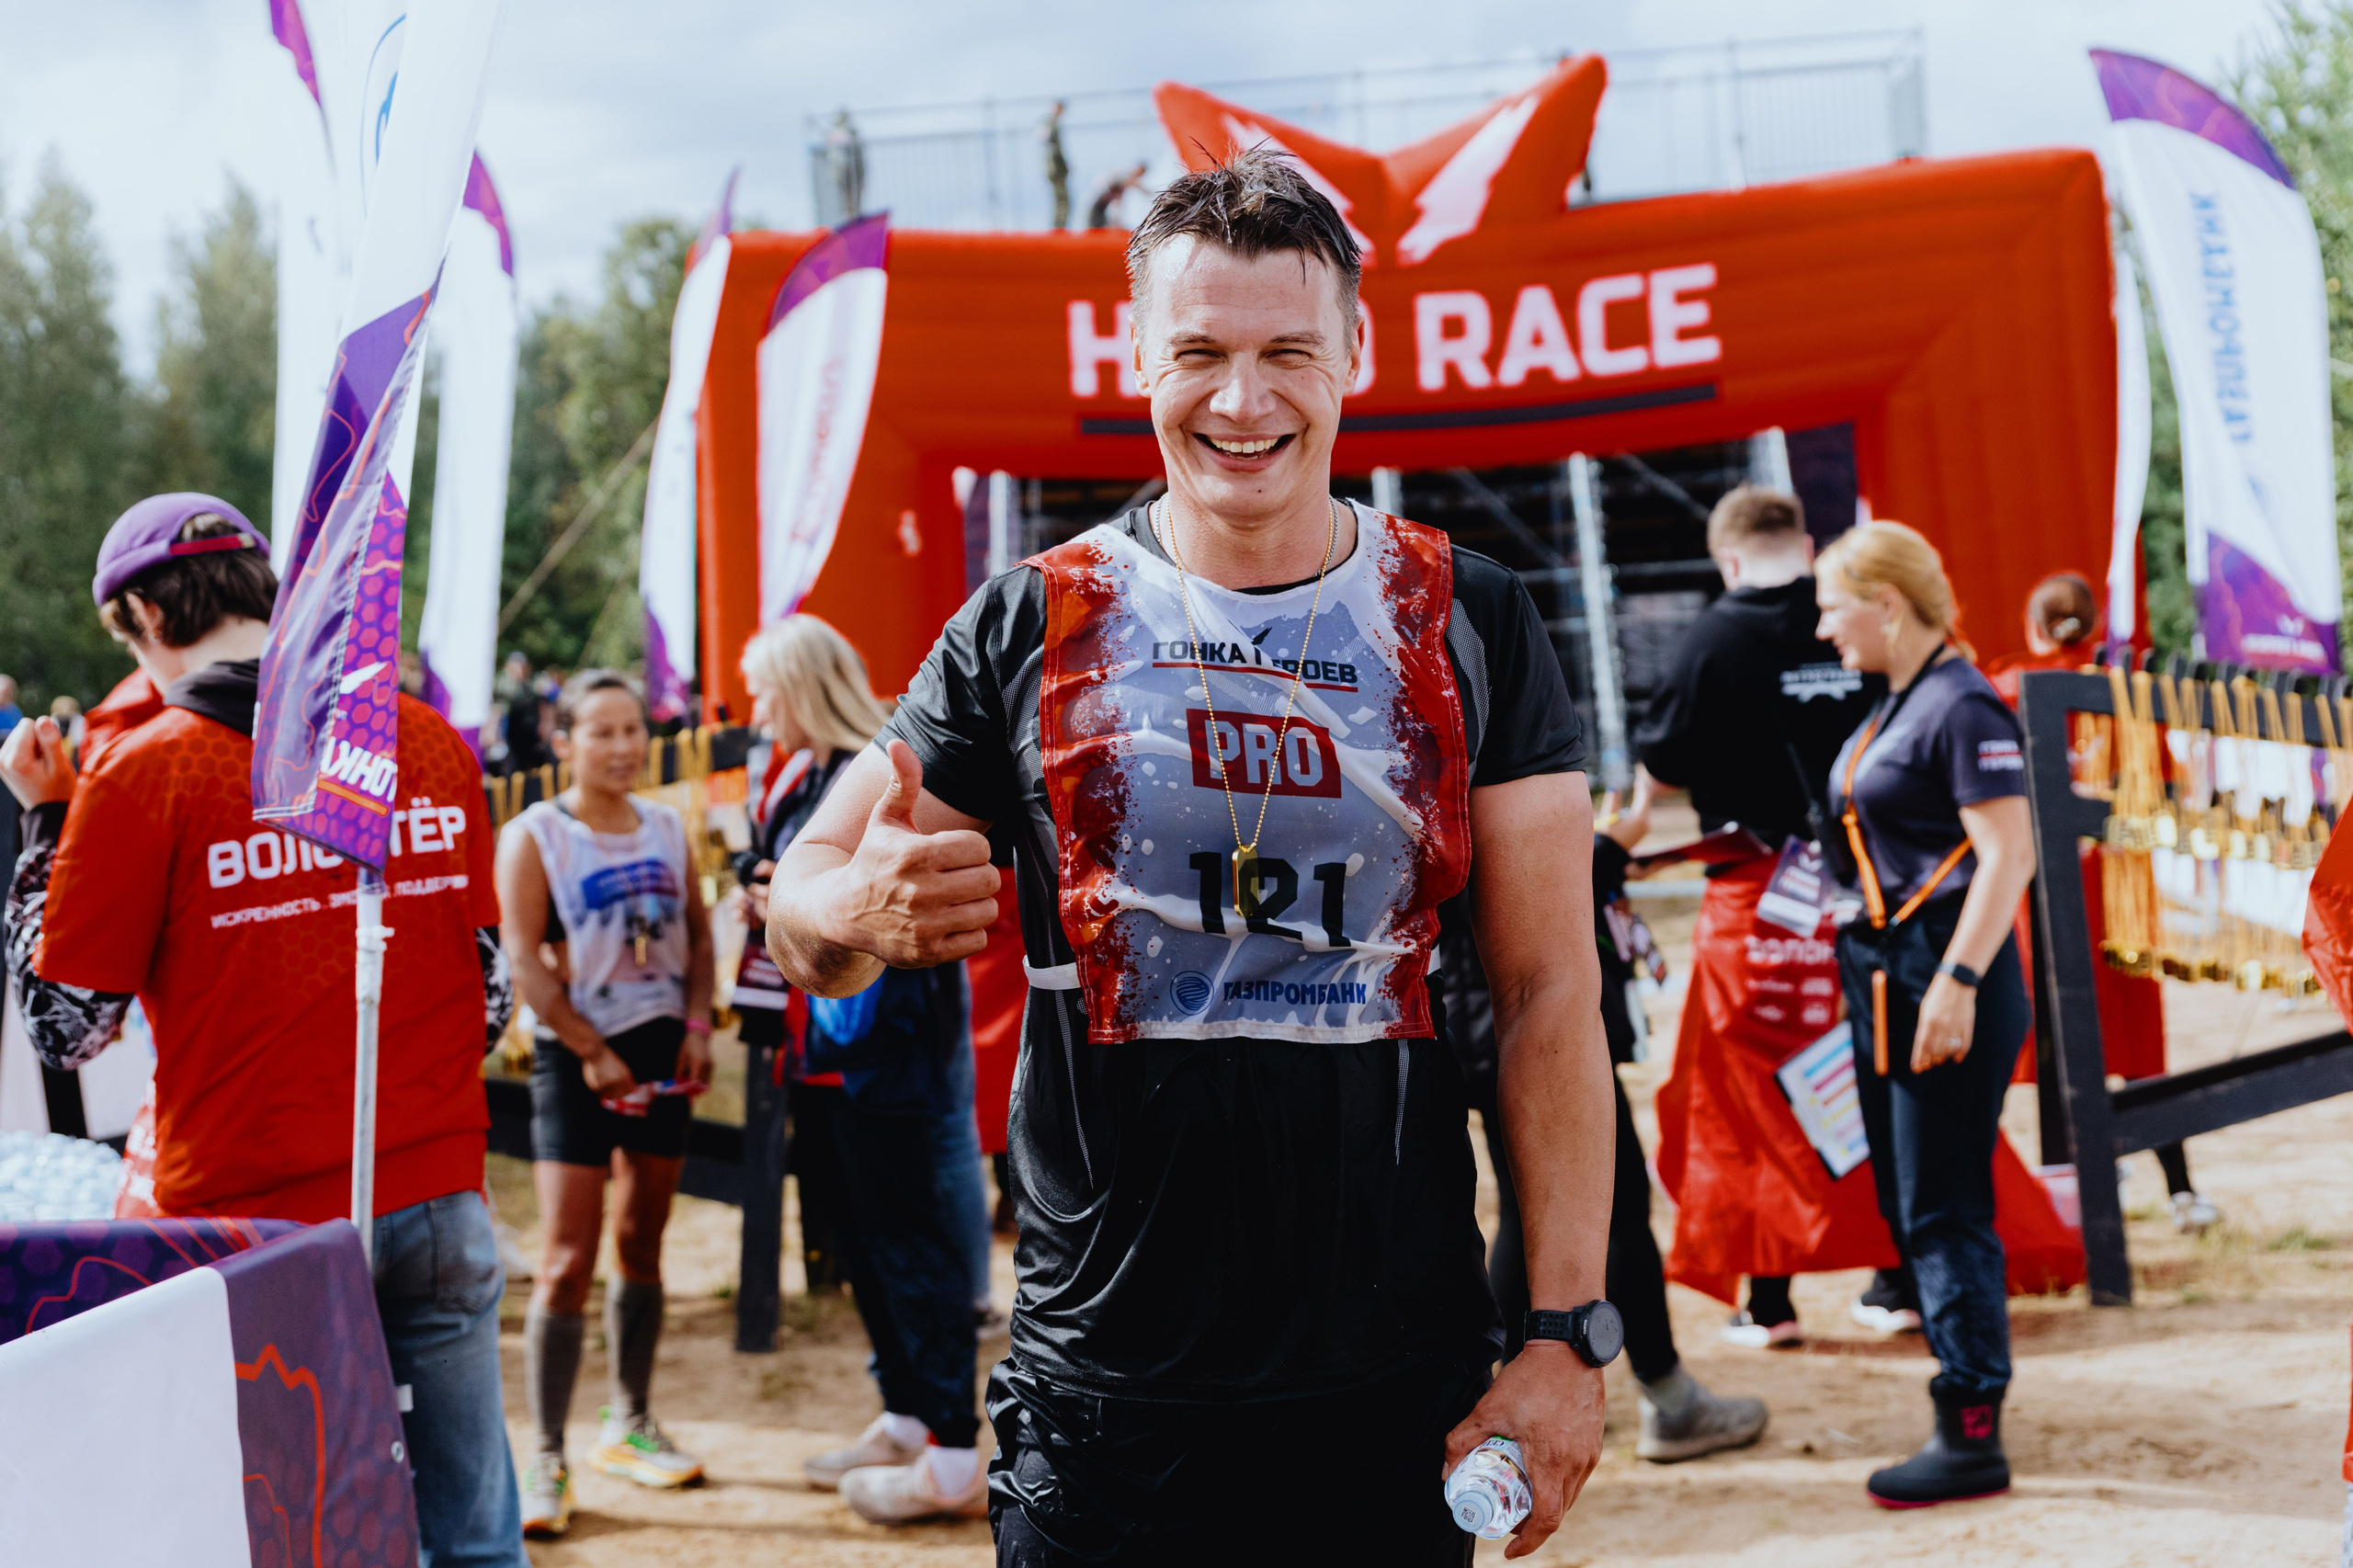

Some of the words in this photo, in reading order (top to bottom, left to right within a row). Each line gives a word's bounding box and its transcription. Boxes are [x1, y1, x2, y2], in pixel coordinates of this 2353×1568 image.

[1415, 262, 1722, 392] RACE
[1152, 641, 1247, 664] ГОНКА
[1204, 719, 1324, 787] PRO
[208, 796, 467, 889] ВОЛТЁР
[1188, 851, 1352, 948] 121
[1223, 980, 1368, 1006] ГАЗПРОМБАНК
